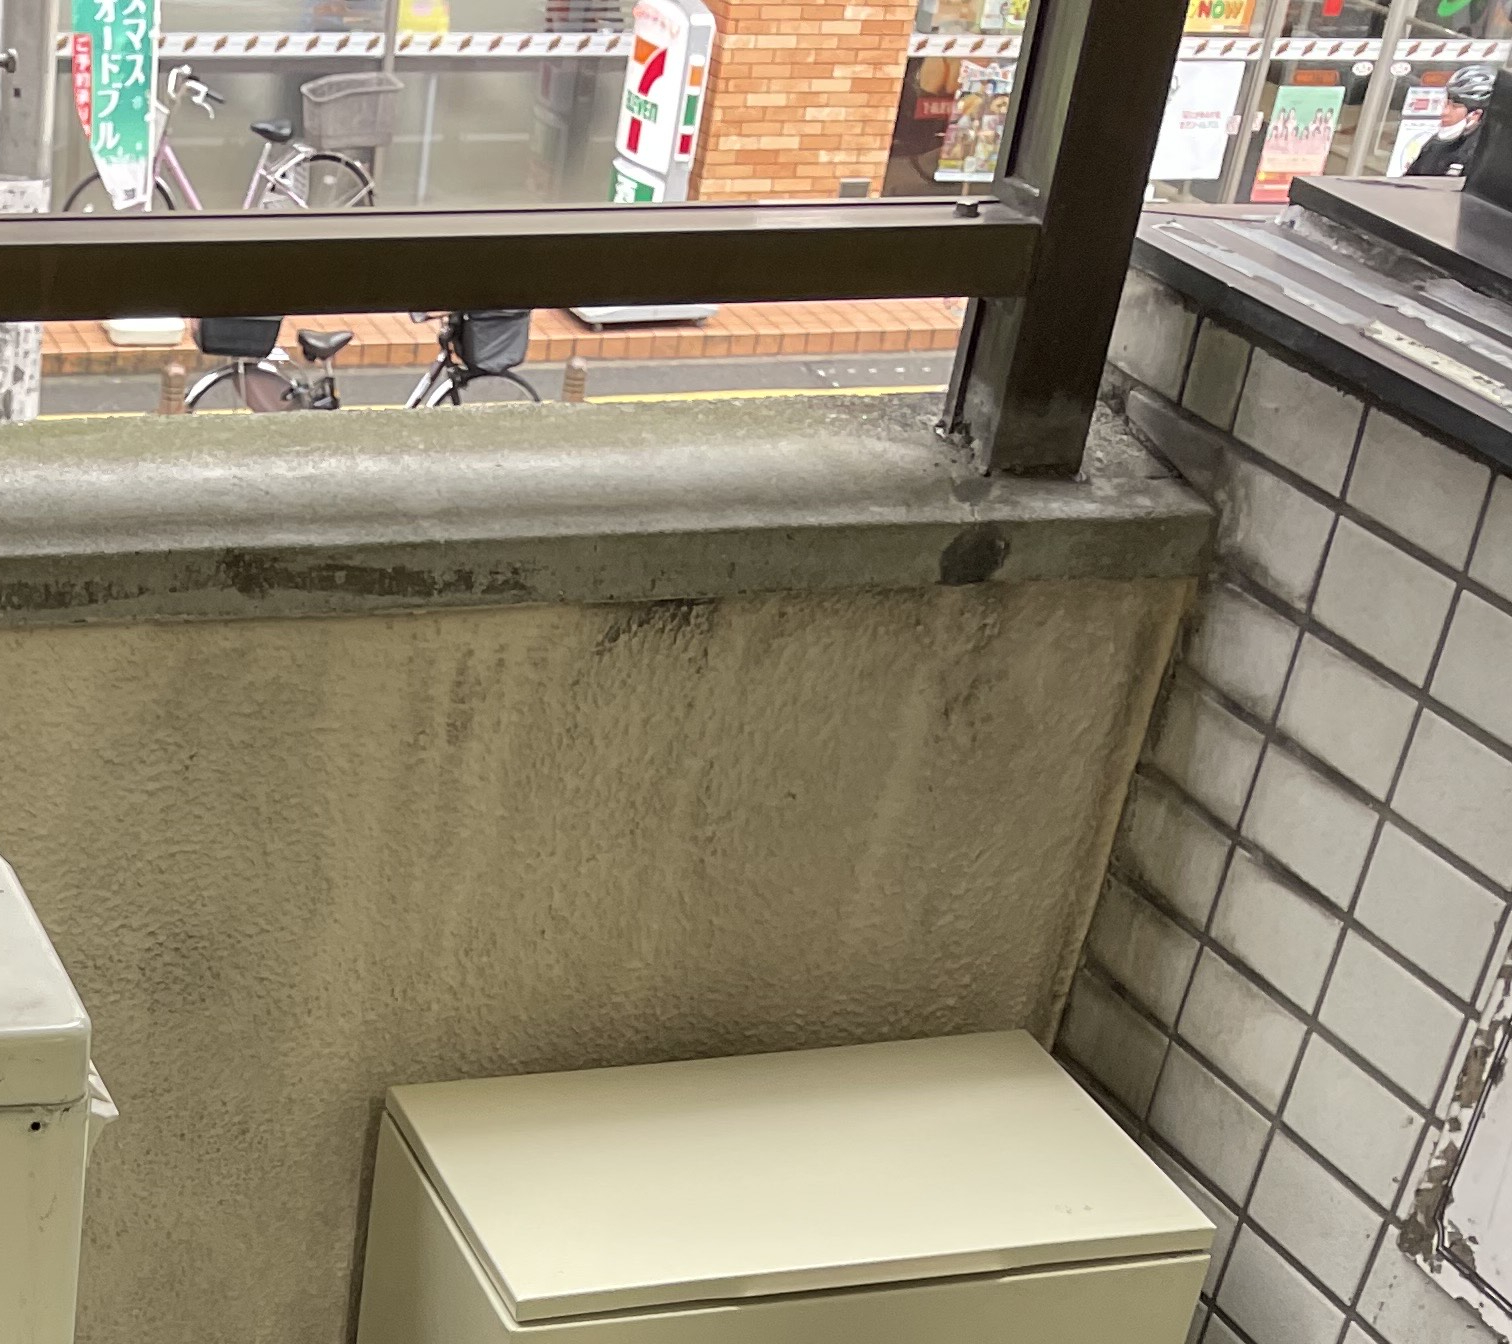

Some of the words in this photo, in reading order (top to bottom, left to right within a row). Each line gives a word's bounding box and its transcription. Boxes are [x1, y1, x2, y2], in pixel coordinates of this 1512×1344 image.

[91, 0, 123, 151] オードブル
